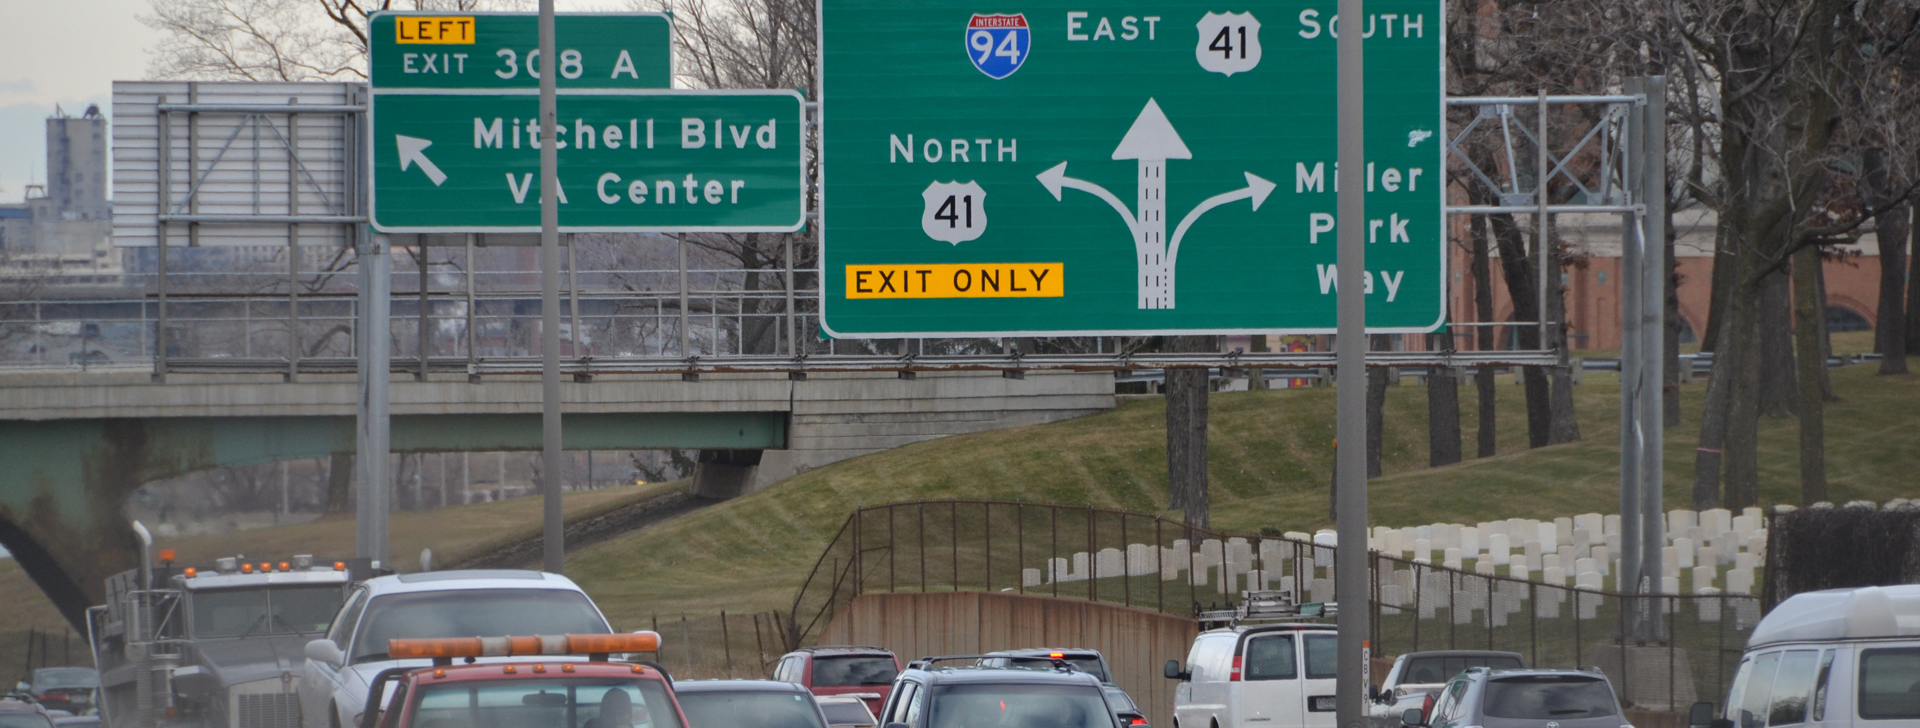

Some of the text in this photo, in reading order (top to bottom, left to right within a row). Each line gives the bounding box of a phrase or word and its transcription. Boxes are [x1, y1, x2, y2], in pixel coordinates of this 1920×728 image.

[400, 21, 470, 40] LEFT
[975, 17, 1020, 27] INTERSTATE
[1066, 11, 1161, 41] EAST
[970, 30, 1020, 65] 94
[1208, 26, 1246, 59] 41
[403, 48, 639, 79] EXIT 308 A
[474, 117, 776, 149] Mitchell Blvd
[890, 133, 1017, 163] NORTH
[597, 172, 745, 204] Center
[1296, 161, 1423, 193] Mler
[934, 195, 972, 228] 41
[1310, 212, 1410, 244] Prk
[856, 269, 1049, 293] EXIT ONLY
